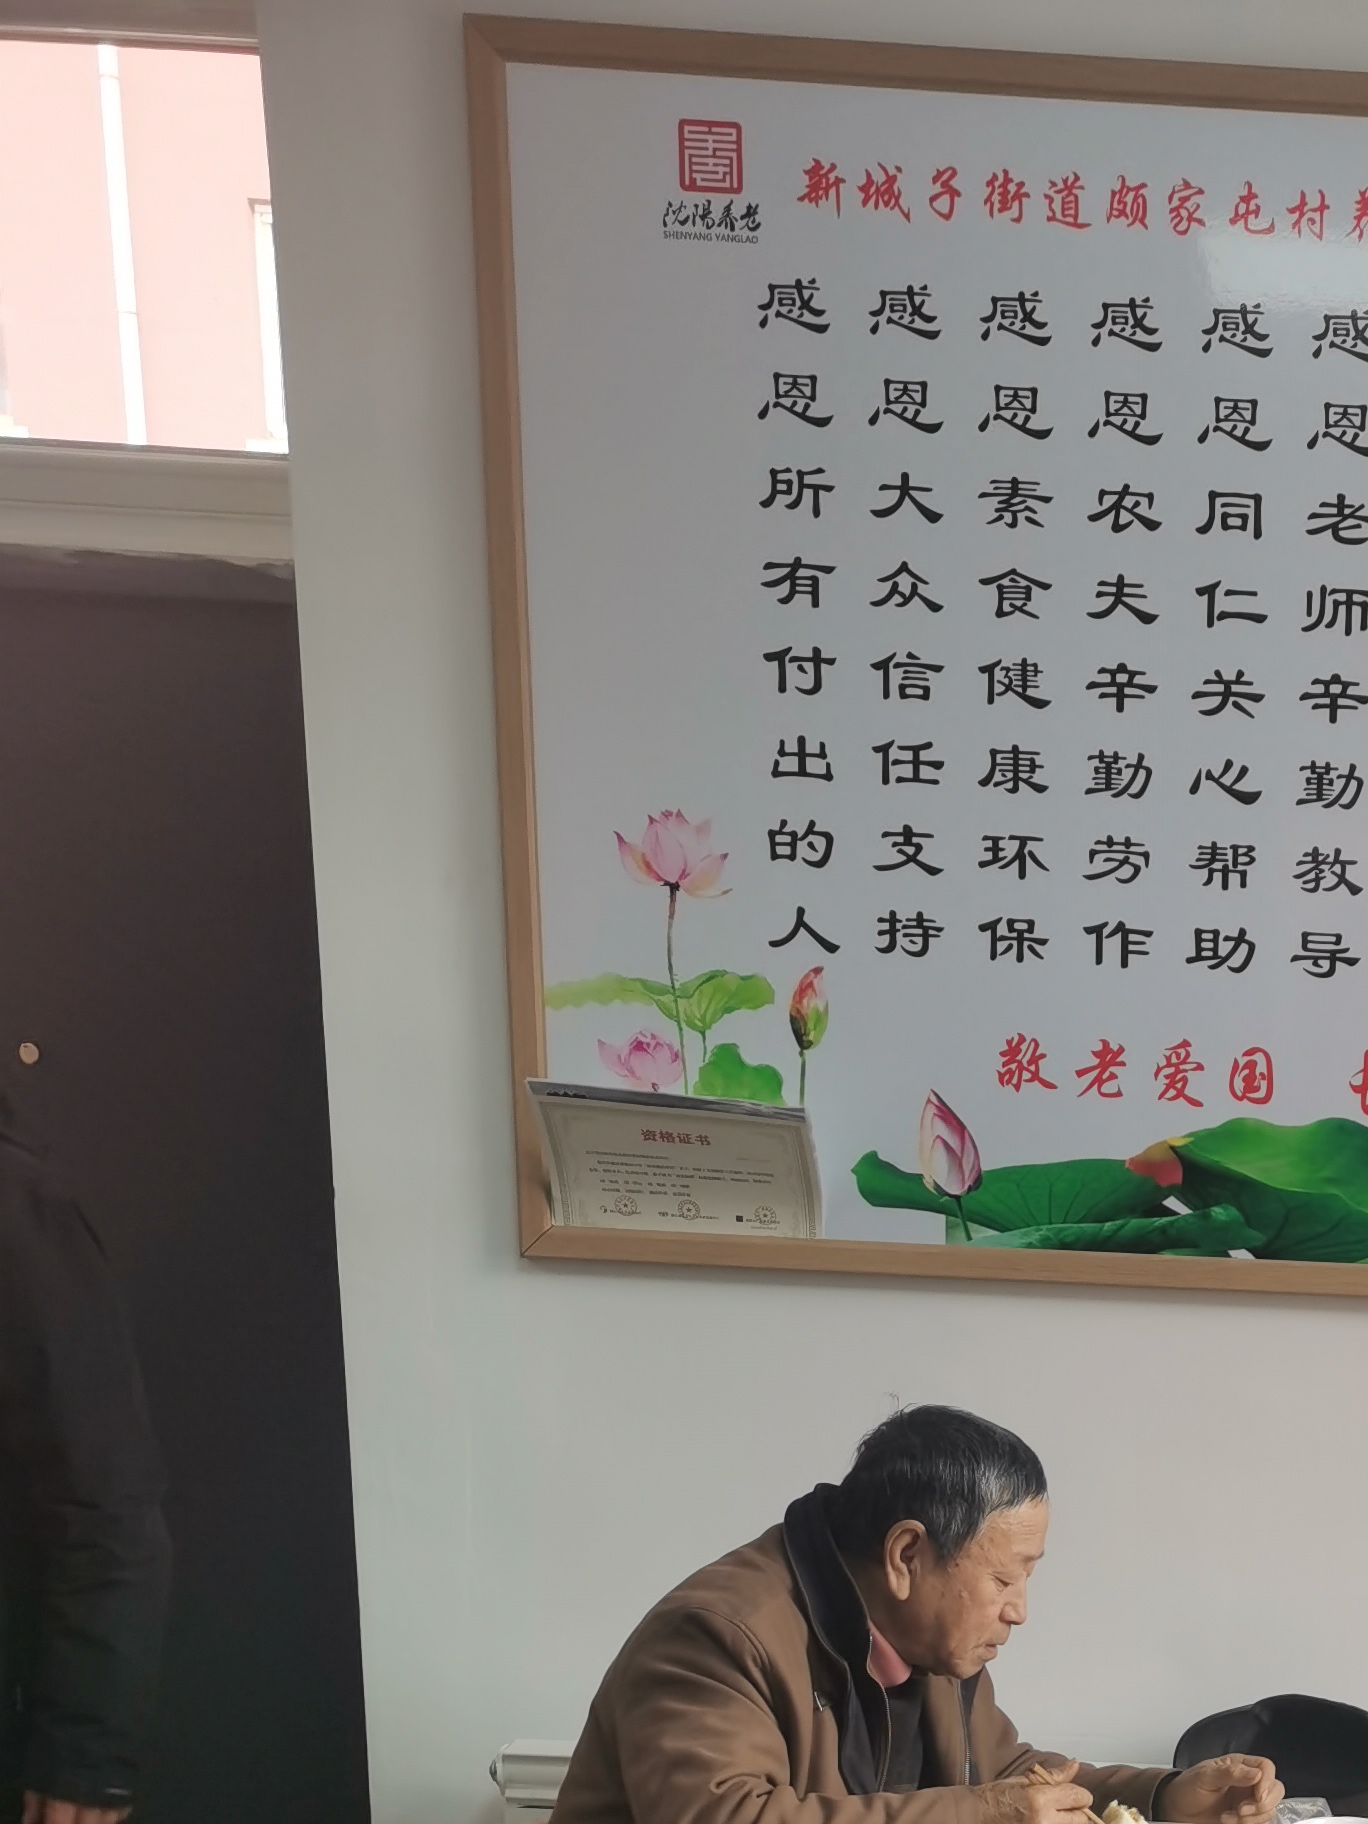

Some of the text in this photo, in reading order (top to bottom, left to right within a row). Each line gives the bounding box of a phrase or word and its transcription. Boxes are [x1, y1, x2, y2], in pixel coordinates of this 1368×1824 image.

[663, 230, 760, 245] SHENYANG YANGLAO
[758, 278, 841, 956] 感恩所有付出的人
[868, 284, 944, 957] 感恩大众信任支持
[978, 291, 1053, 963] 感恩素食健康环保
[1083, 297, 1163, 968] 感恩农夫辛勤劳作
[1186, 304, 1273, 973] 感恩同仁关心帮助
[641, 1128, 711, 1146] 资格证书
[996, 1034, 1274, 1108] 敬老爱国
